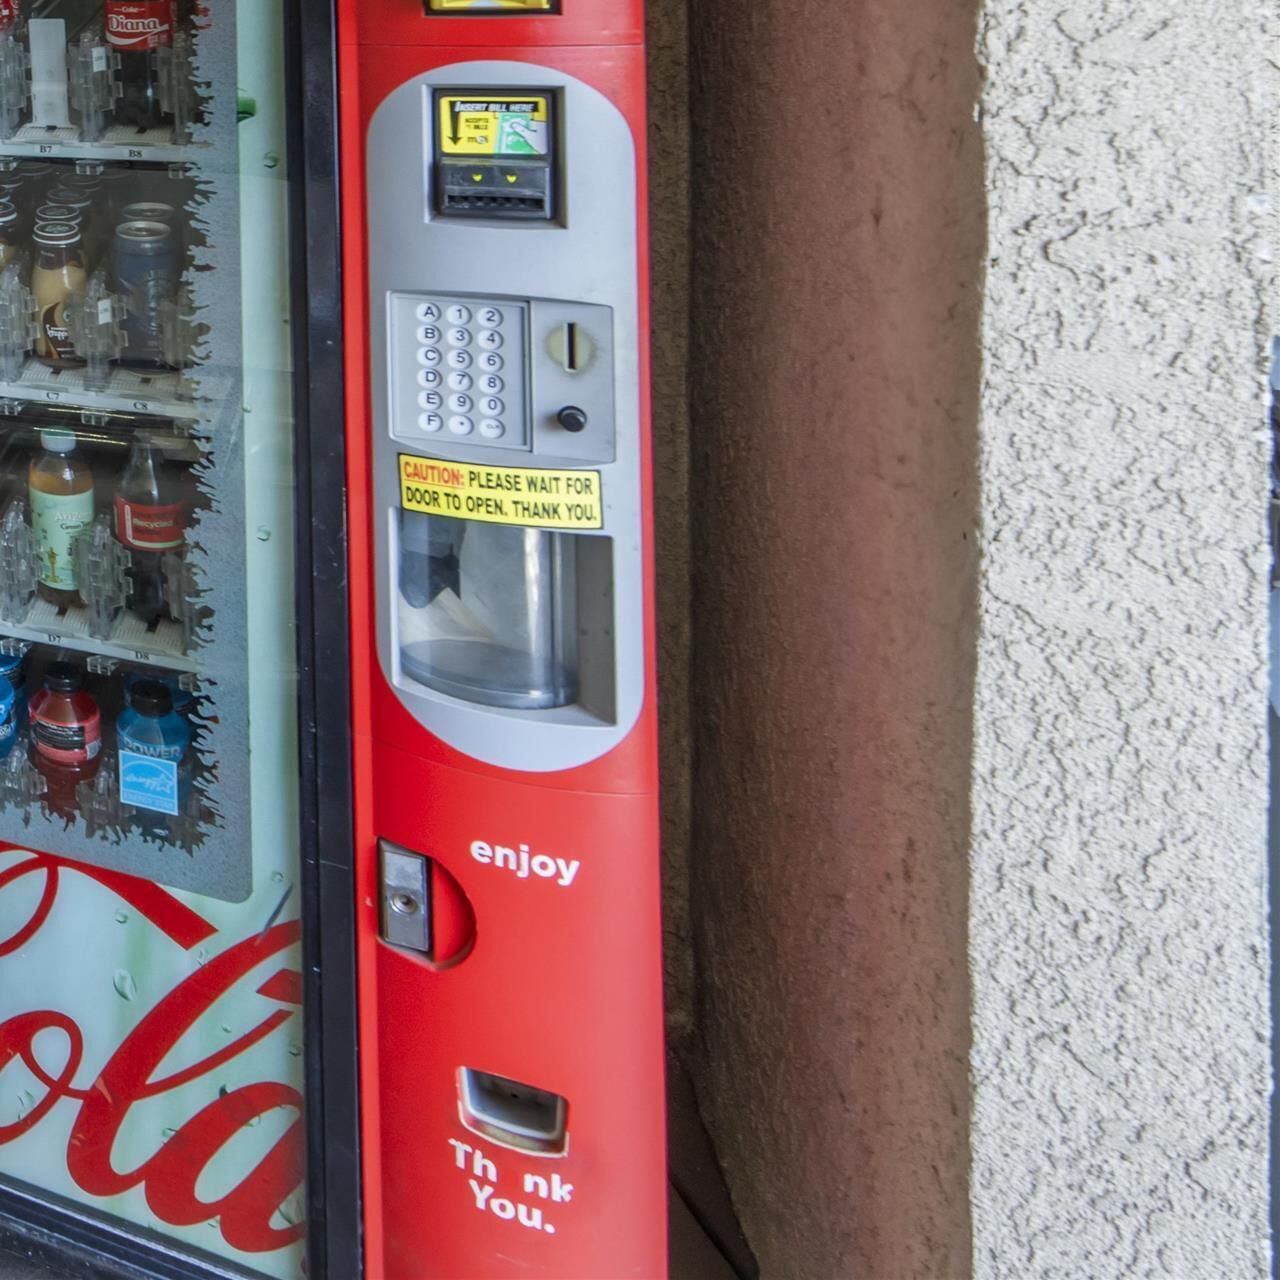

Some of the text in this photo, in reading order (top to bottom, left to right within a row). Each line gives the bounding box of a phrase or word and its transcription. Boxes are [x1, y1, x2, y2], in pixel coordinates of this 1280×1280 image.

[108, 14, 159, 32] Diana
[454, 101, 535, 112] INSERT BILL HERE
[40, 145, 52, 153] B7
[129, 149, 142, 157] B8
[424, 306, 435, 318] A
[456, 308, 463, 319] 1
[486, 310, 496, 322] 2
[425, 327, 436, 339] B
[456, 330, 465, 341] 3
[487, 333, 496, 343] 4
[425, 349, 436, 361] C
[456, 352, 465, 363] 5
[487, 355, 496, 366] 6
[425, 371, 437, 382] D
[456, 373, 466, 385] 7
[488, 377, 497, 388] 8
[46, 392, 59, 400] C7
[134, 402, 148, 411] C8
[426, 393, 437, 404] E
[457, 396, 466, 407] 9
[488, 399, 497, 410] 0
[427, 415, 436, 426] F
[404, 461, 593, 495] CAUTION: PLEASE WAIT FOR
[405, 486, 597, 521] DOOR TO OPEN. THANK YOU.
[48, 635, 61, 644] D7
[135, 651, 149, 660] D8
[470, 840, 580, 886] enjoy
[448, 1138, 574, 1202] Thnk
[468, 1178, 556, 1234] You.
